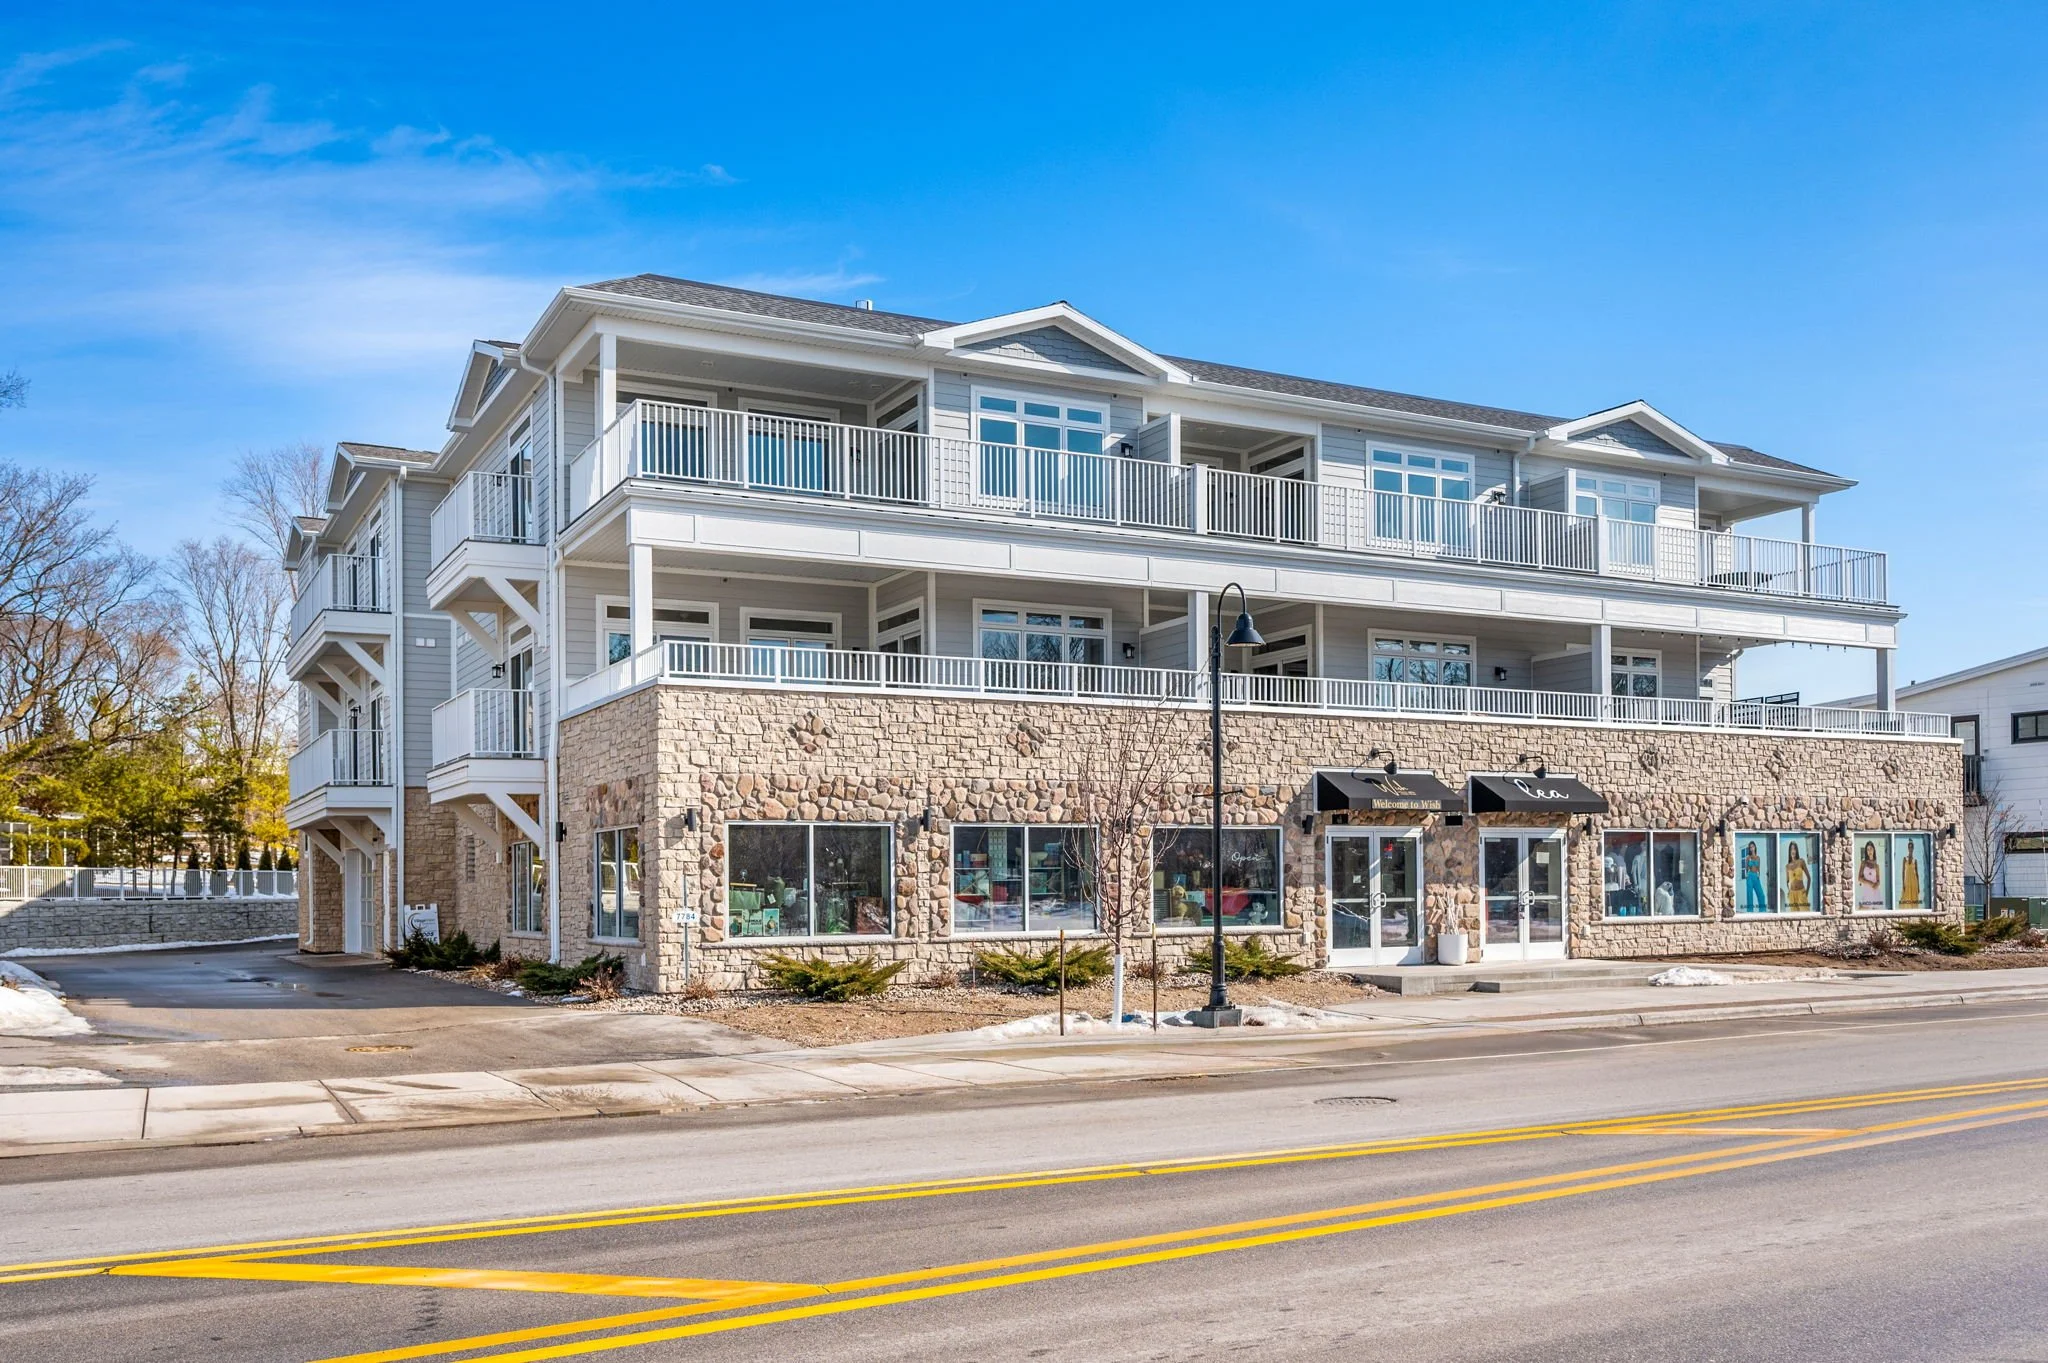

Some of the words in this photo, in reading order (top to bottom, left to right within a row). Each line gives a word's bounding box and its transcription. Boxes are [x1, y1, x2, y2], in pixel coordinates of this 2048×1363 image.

[1372, 799, 1409, 809] Welcome
[1410, 800, 1419, 809] to
[1419, 799, 1441, 809] Wish
